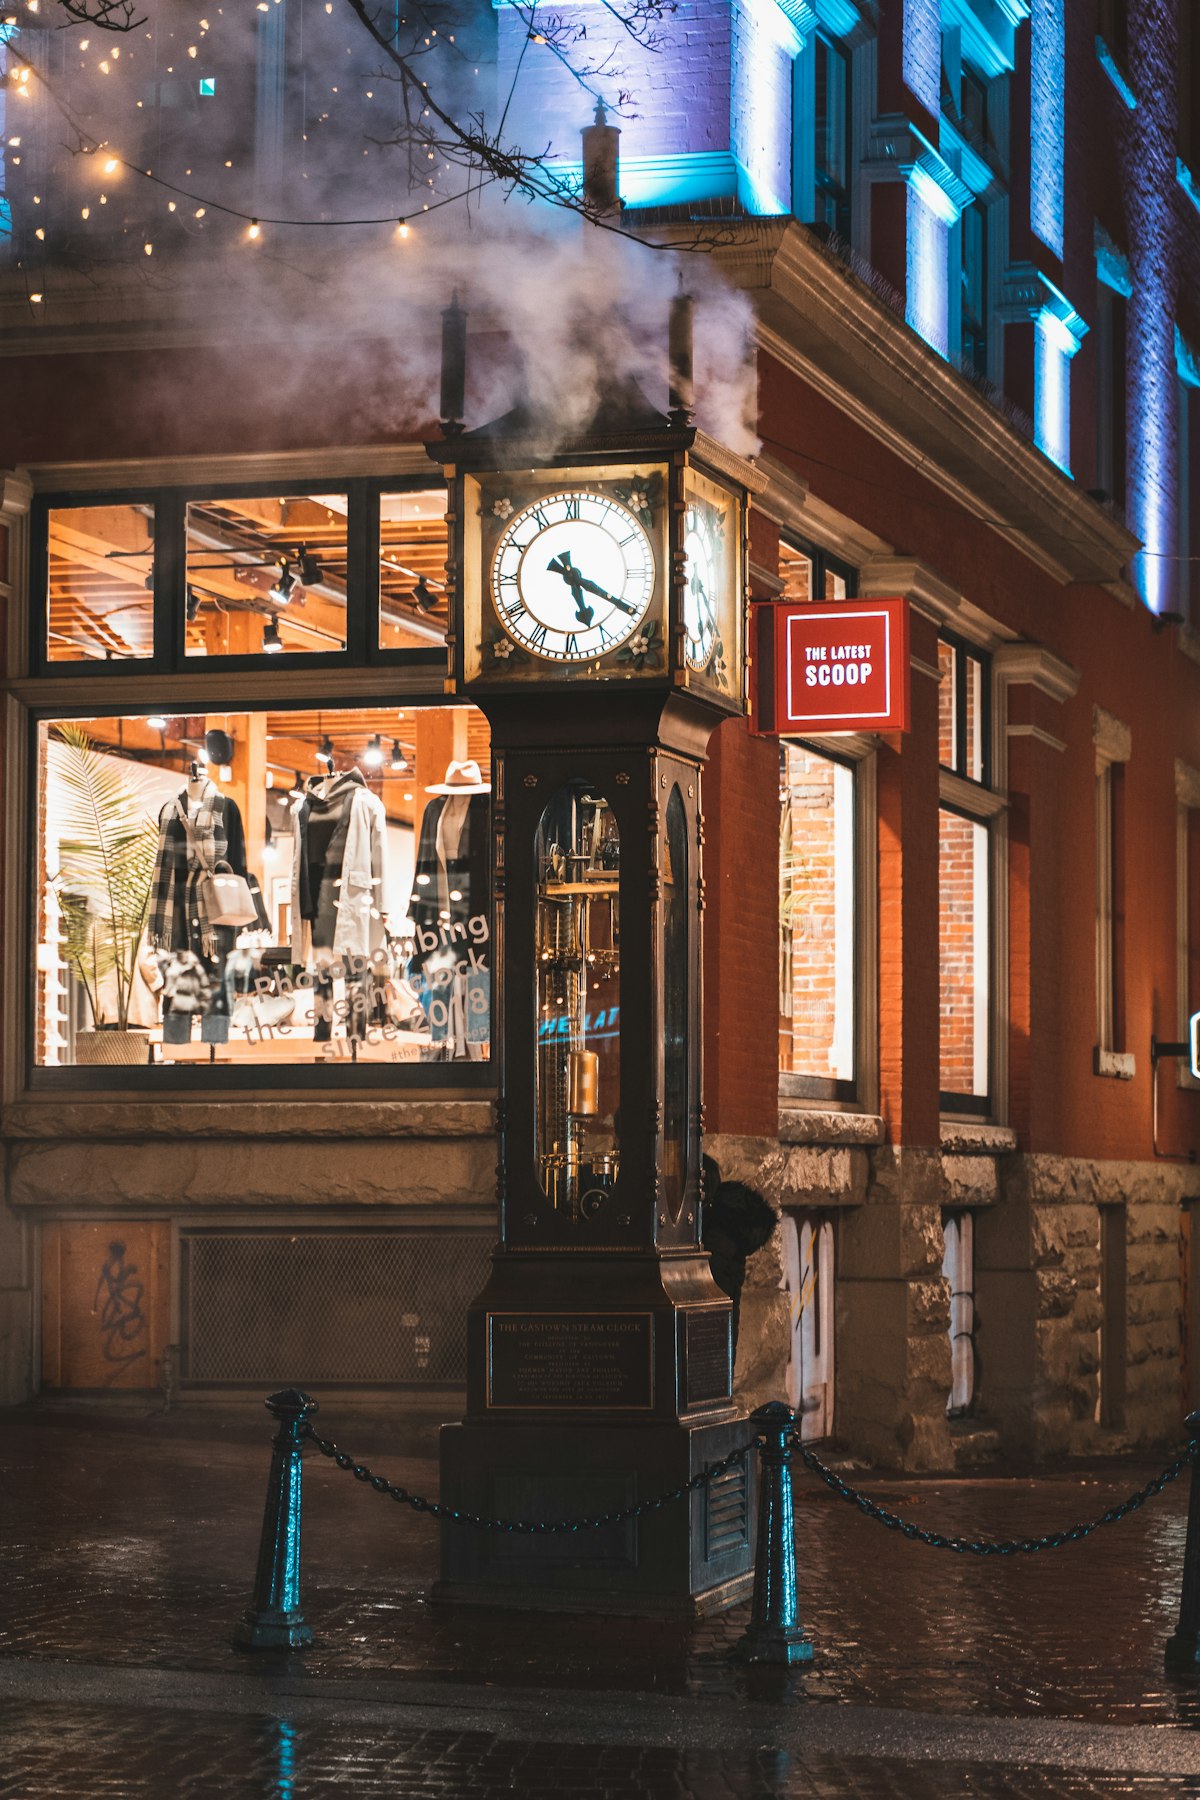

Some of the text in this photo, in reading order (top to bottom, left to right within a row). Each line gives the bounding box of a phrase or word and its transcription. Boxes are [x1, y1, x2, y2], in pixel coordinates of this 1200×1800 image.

[805, 645, 871, 661] THE LATEST
[805, 663, 872, 687] SCOOP
[242, 948, 489, 1045] the steam clock
[321, 1023, 398, 1061] since
[499, 1323, 641, 1332] THE GASTOWN STEAM CLOCK
